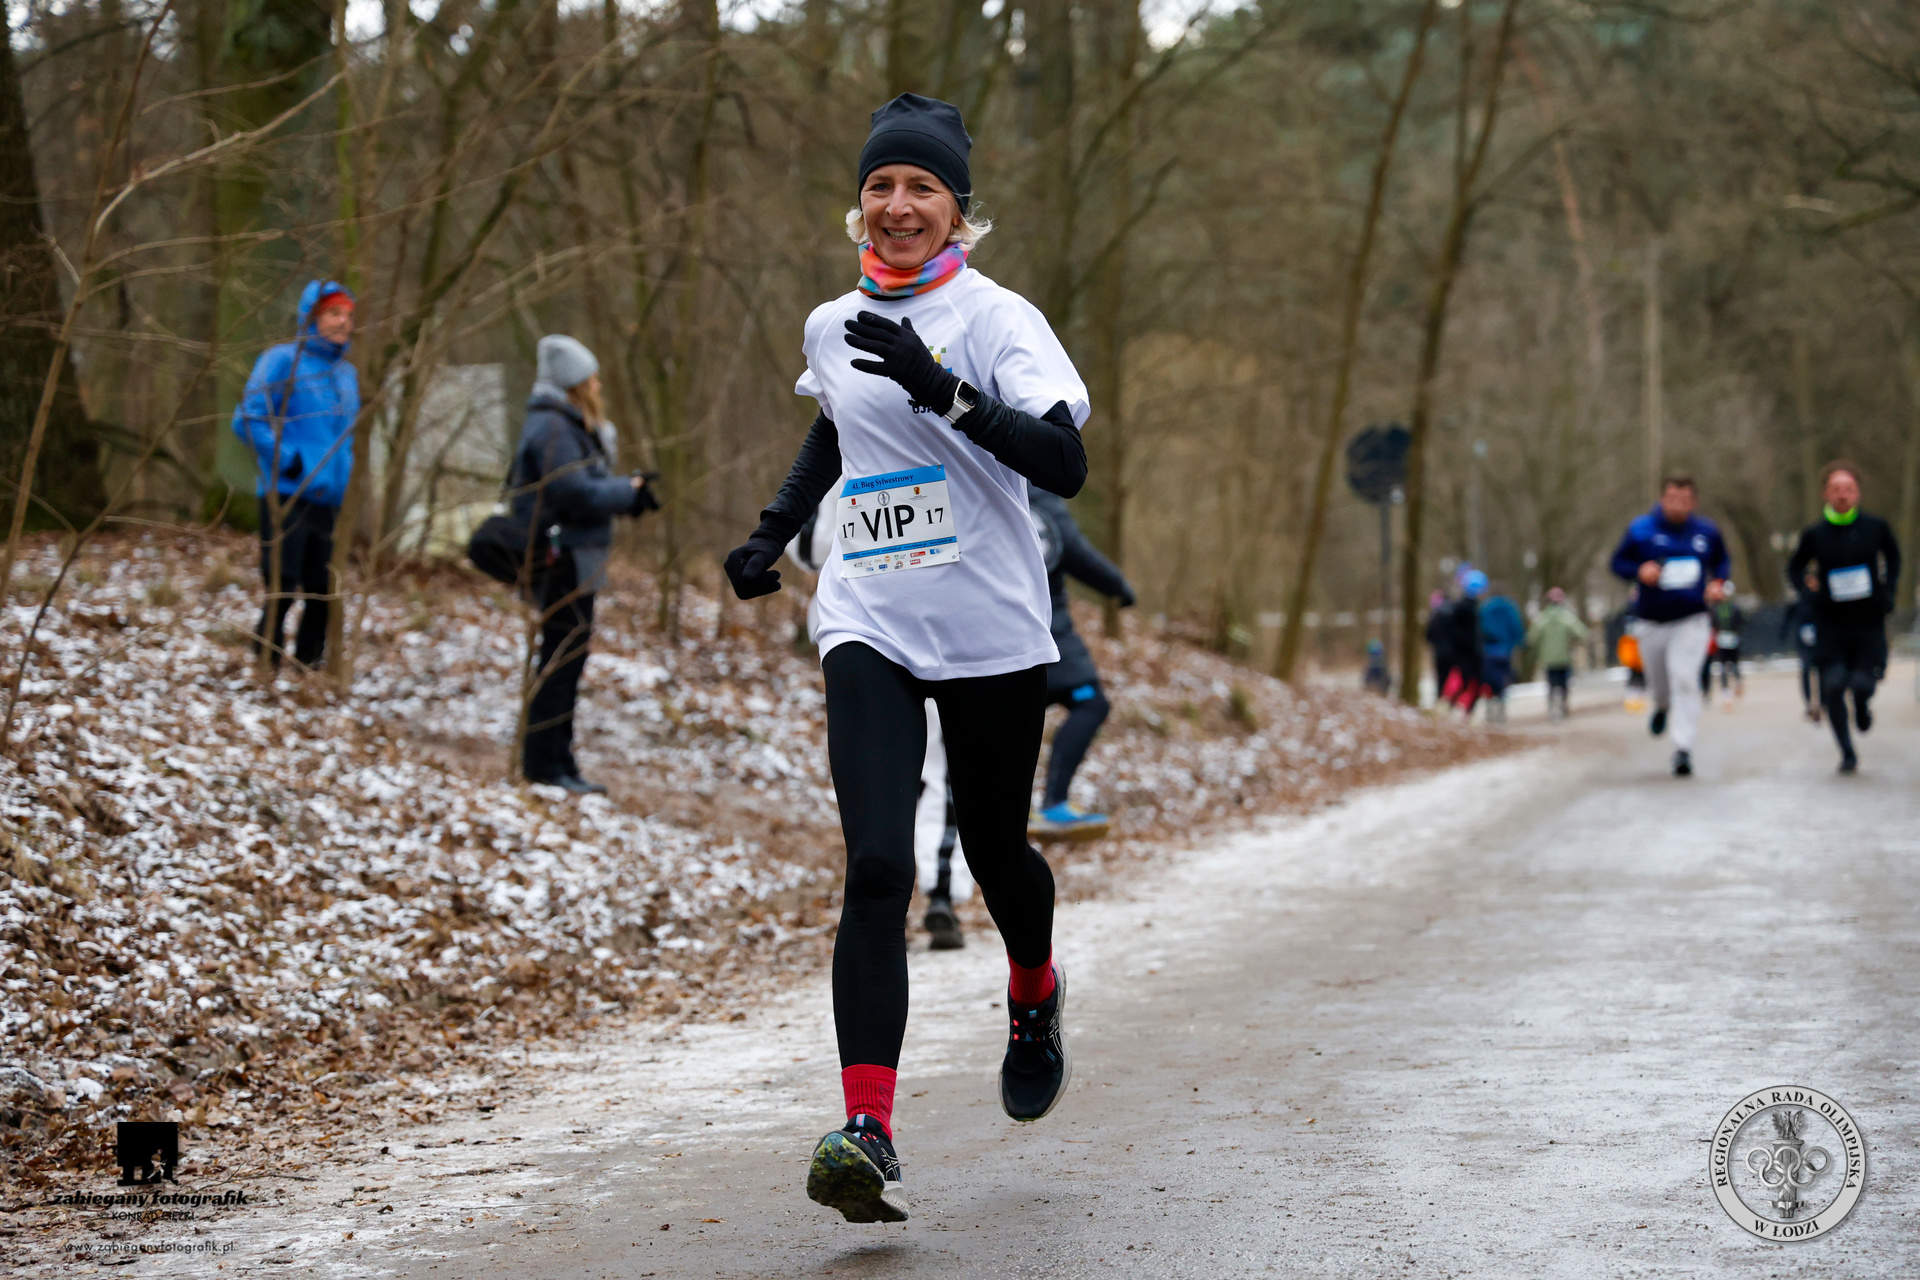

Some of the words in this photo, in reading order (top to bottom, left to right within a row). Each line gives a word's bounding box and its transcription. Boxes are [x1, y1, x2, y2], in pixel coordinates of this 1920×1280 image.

[861, 480, 875, 489] Bieg
[875, 474, 914, 487] Sylwestrowy
[842, 522, 855, 539] 17
[860, 504, 915, 542] VIP
[926, 507, 944, 525] 17
